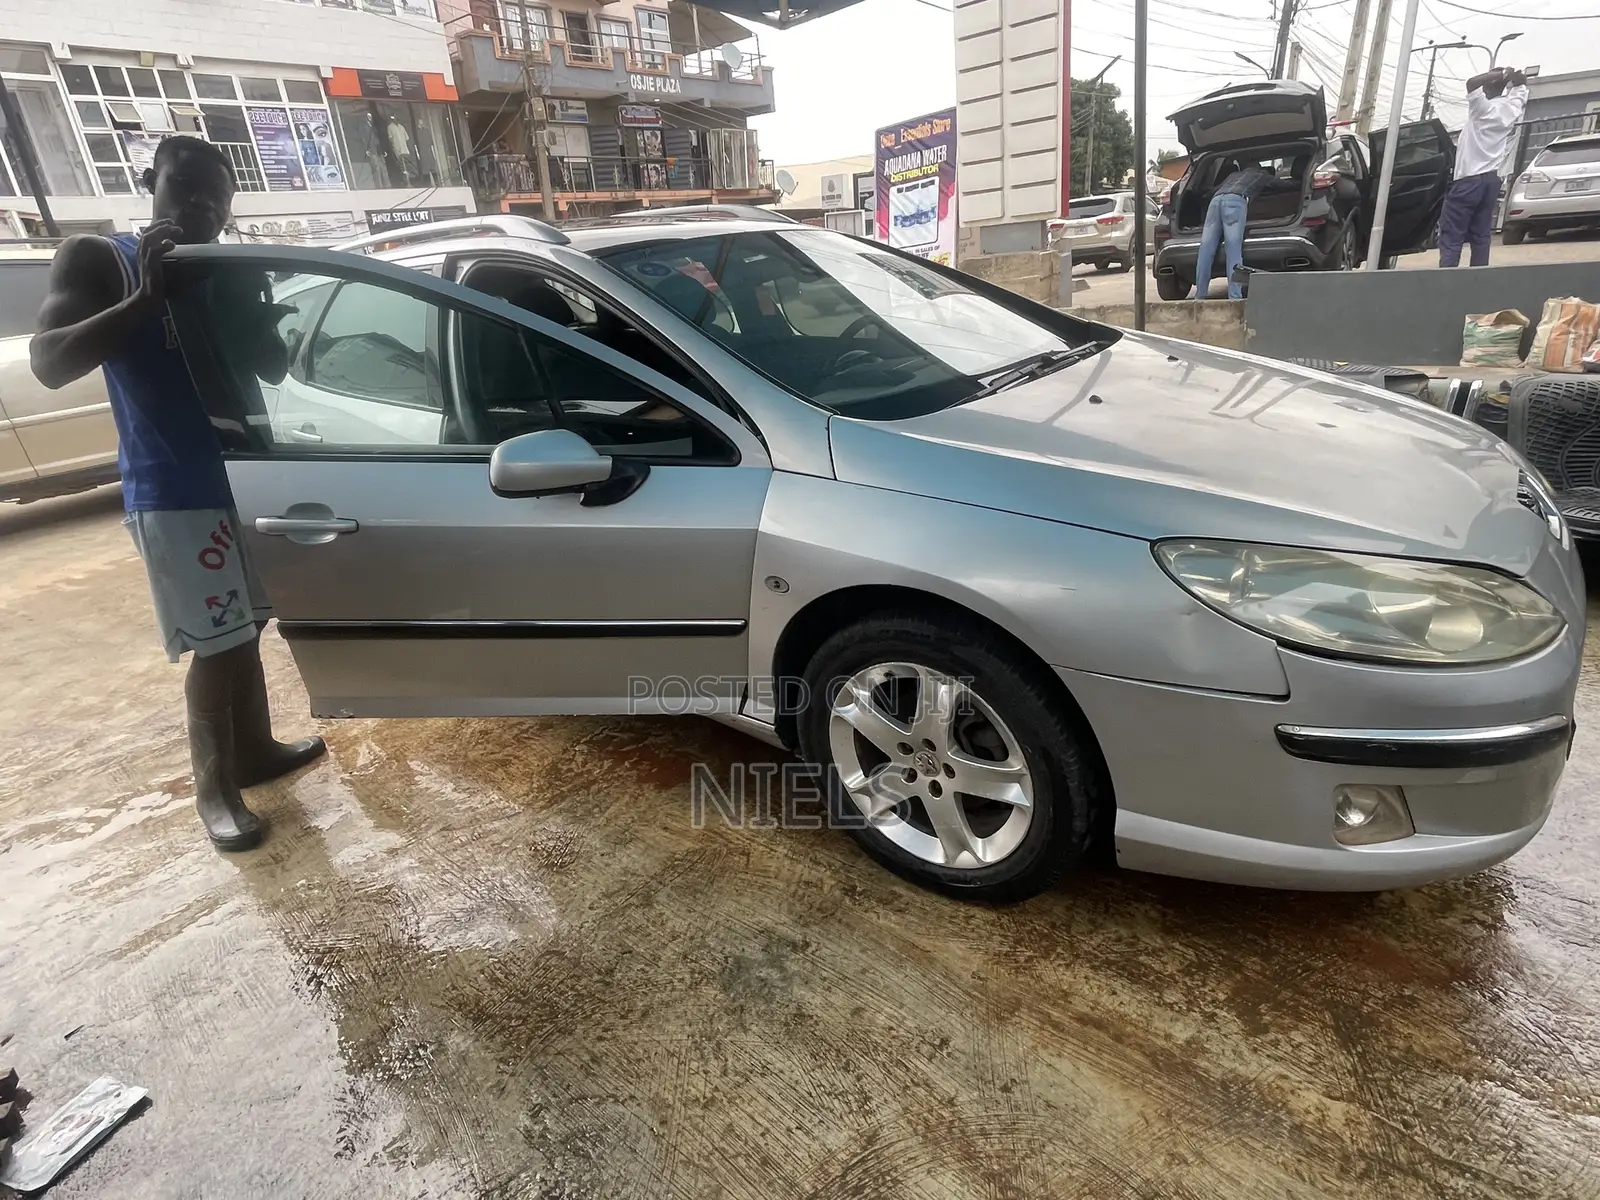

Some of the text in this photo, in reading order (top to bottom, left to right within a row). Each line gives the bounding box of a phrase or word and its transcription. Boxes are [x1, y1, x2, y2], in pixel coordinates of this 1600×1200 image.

[630, 74, 681, 93] OSJIE PLAZA
[884, 144, 947, 176] AQUADANA WATER
[890, 163, 939, 183] DISTRIBUTOR
[412, 210, 429, 221] LOFT
[198, 519, 234, 570] Off
